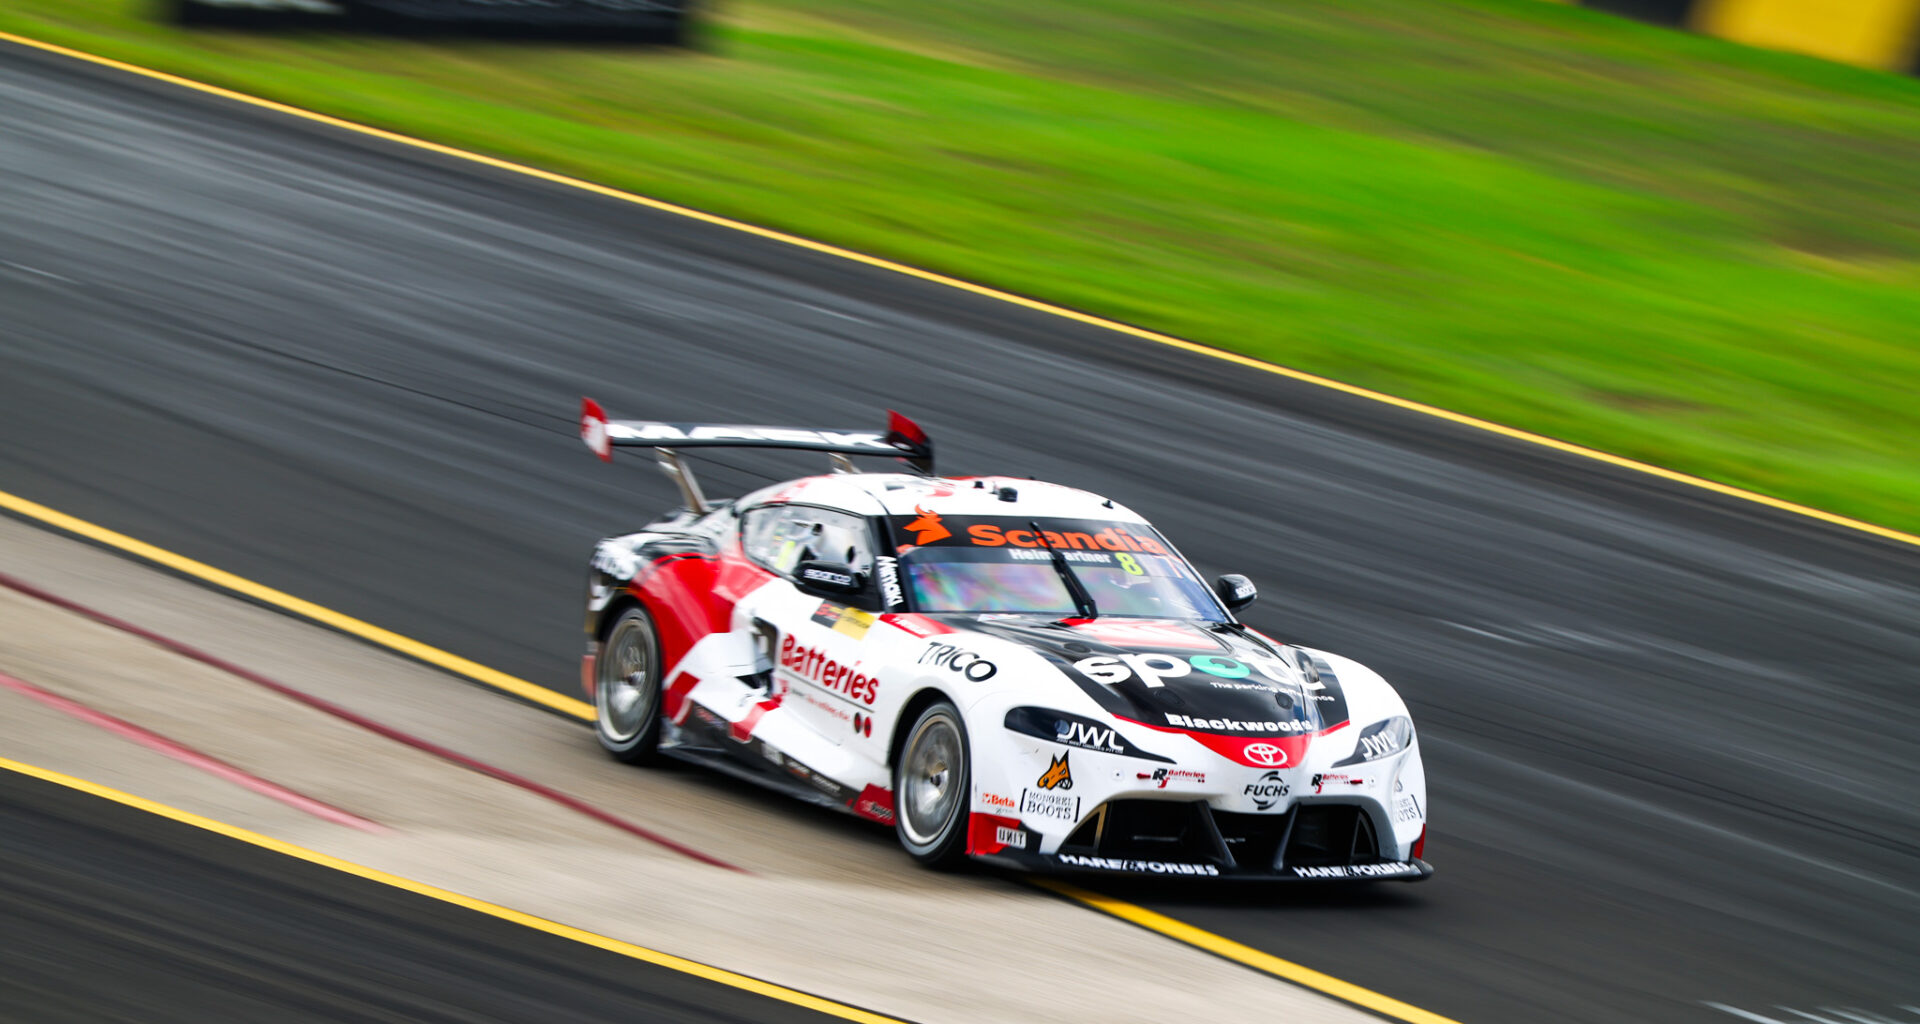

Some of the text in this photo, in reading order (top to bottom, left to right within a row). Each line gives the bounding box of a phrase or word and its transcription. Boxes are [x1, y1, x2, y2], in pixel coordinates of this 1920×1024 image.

[967, 524, 1170, 554] Scandia
[1008, 548, 1144, 575] Heimartner 8
[781, 633, 879, 705] Batteries
[917, 641, 998, 682] TRICO
[1164, 711, 1313, 732] Blackwoods
[1057, 721, 1124, 750] JWL
[1168, 769, 1206, 779] Batteries
[991, 794, 1015, 808] Beta
[1244, 784, 1291, 797] FUCHS
[1026, 801, 1072, 820] BOOTS
[998, 828, 1025, 847] UNIT
